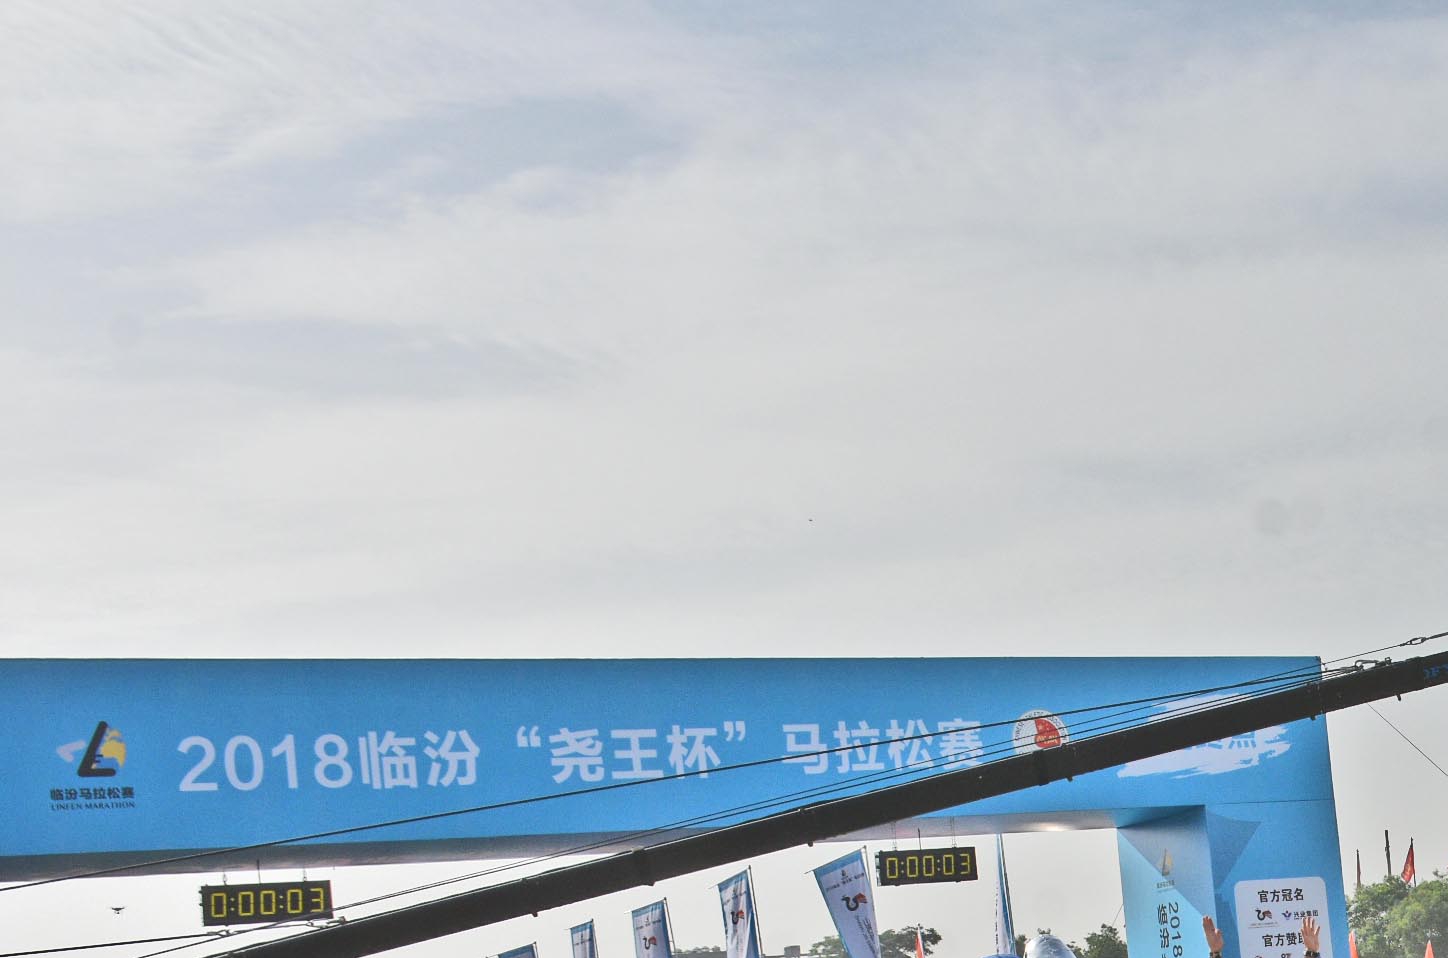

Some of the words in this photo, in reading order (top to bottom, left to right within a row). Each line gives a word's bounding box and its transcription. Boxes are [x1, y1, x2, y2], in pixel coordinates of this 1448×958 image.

[178, 728, 480, 792] 2018临汾
[516, 720, 746, 784] “尧王杯”
[782, 716, 984, 776] 马拉松赛
[50, 786, 135, 801] 临汾马拉松赛
[85, 800, 135, 810] MARATHON
[887, 853, 970, 879] 0:00:03
[211, 887, 325, 918] 0:00:03
[1257, 887, 1304, 903] 官方冠名
[1168, 901, 1183, 958] 2018
